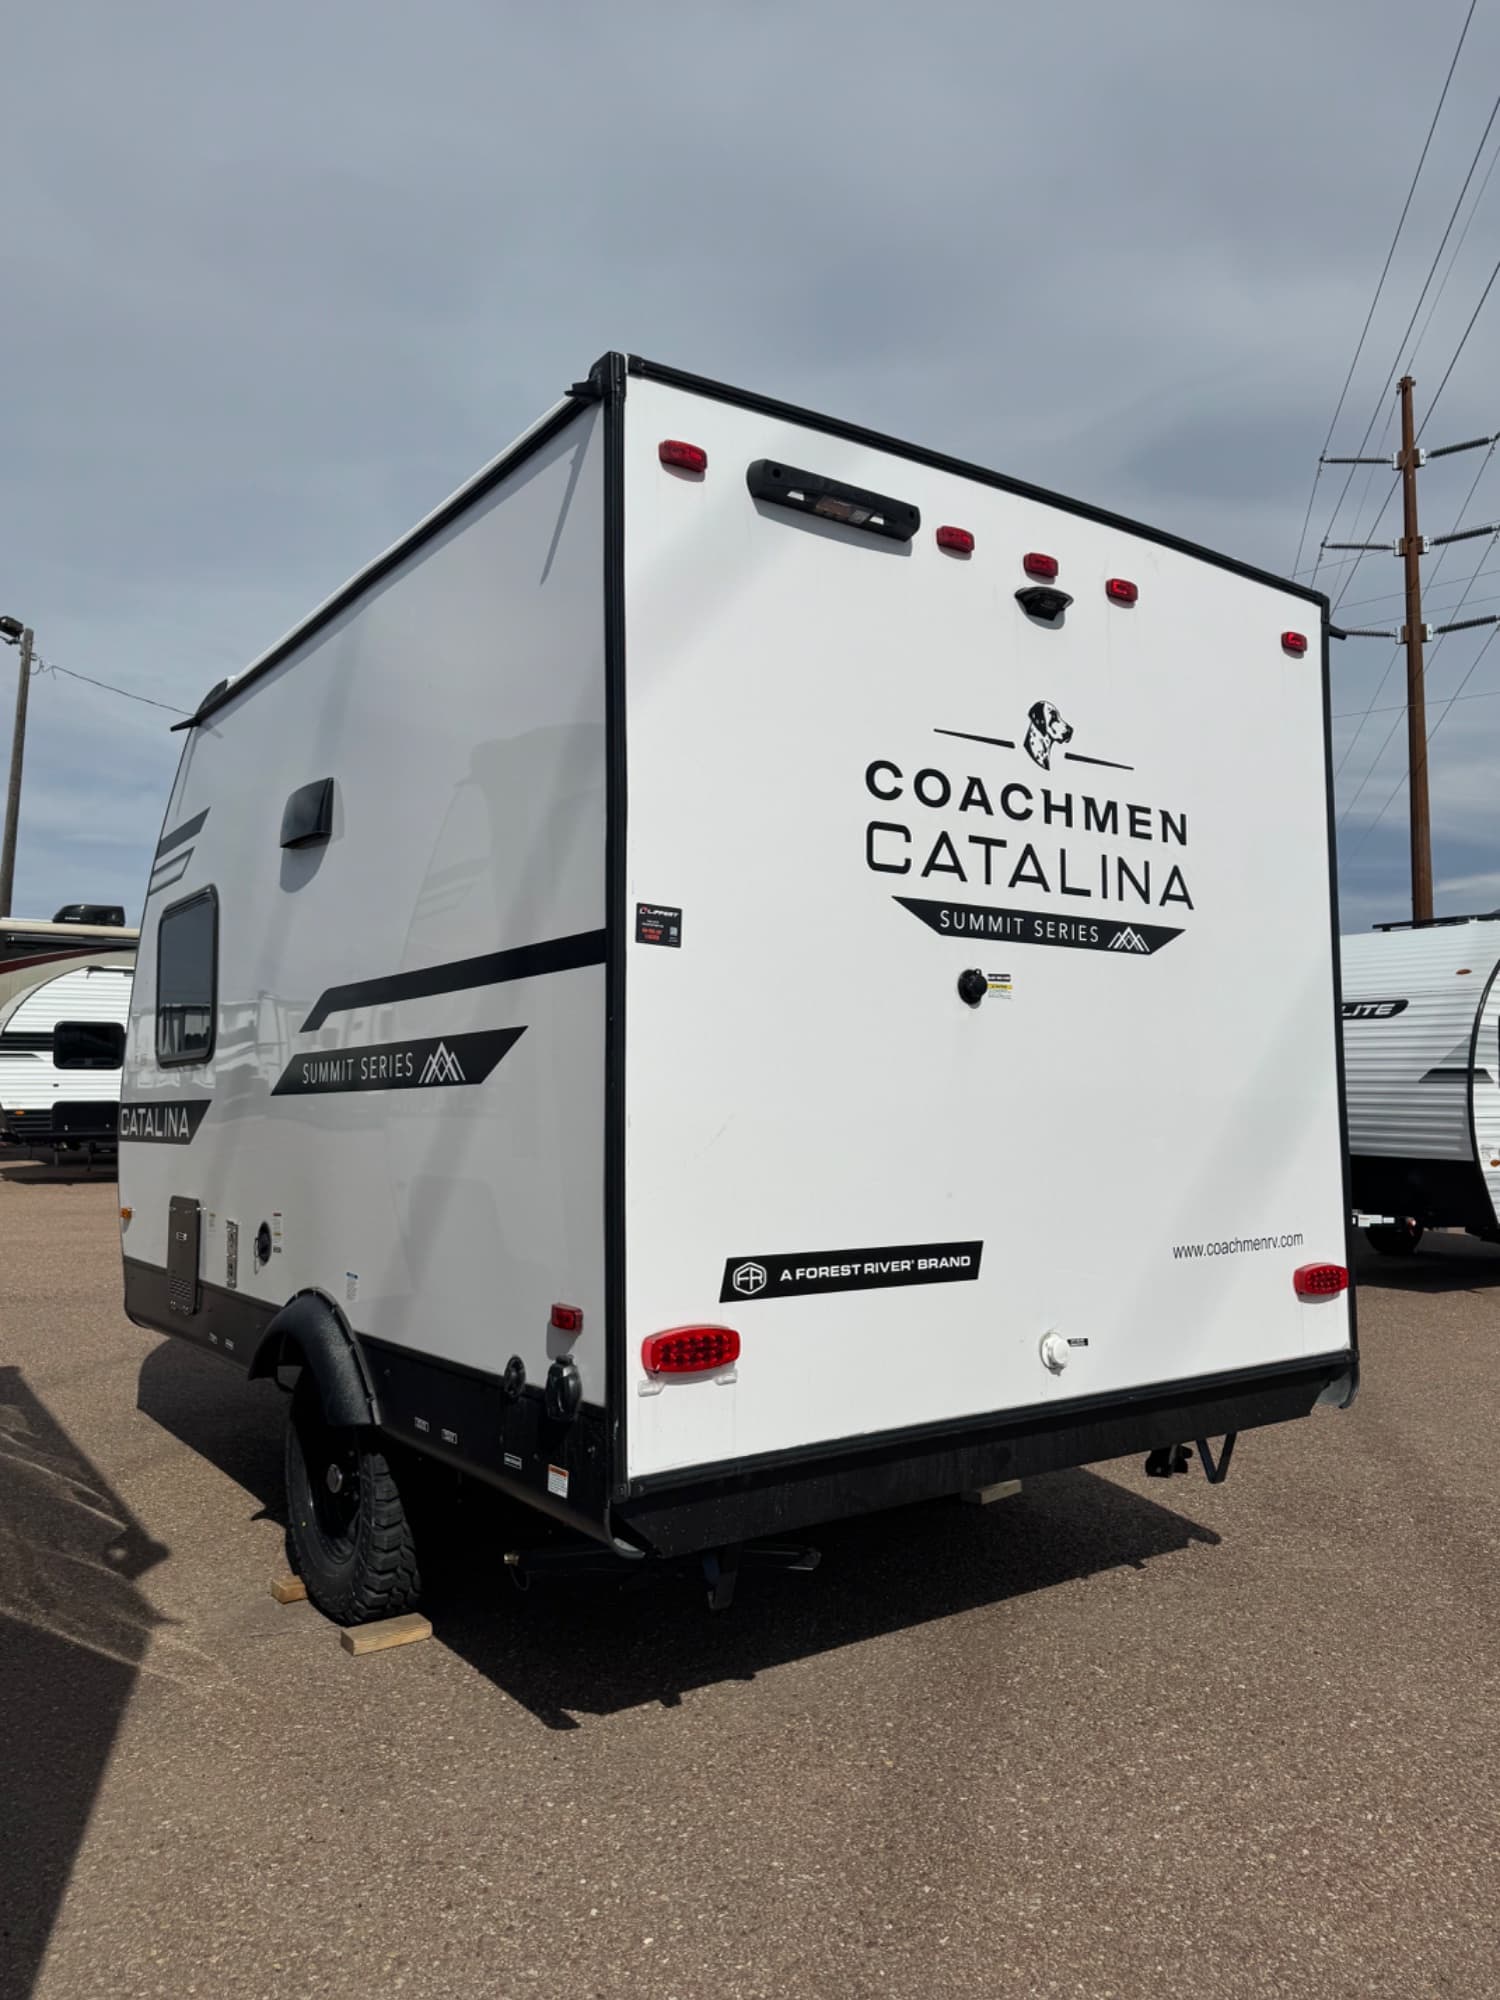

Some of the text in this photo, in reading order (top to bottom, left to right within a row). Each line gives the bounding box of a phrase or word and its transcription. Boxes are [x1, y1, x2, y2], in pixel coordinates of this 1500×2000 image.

[865, 759, 1188, 846] COACHMEN
[866, 820, 1195, 911] CATALINA
[939, 910, 1100, 943] SUMMIT SERIES
[302, 1052, 414, 1085] SUMMIT SERIES
[120, 1106, 190, 1139] CATALINA
[1172, 1232, 1304, 1259] www.coachmenrv.com
[779, 1269, 793, 1282] A
[795, 1263, 862, 1280] FOREST
[917, 1255, 972, 1270] BRAND
